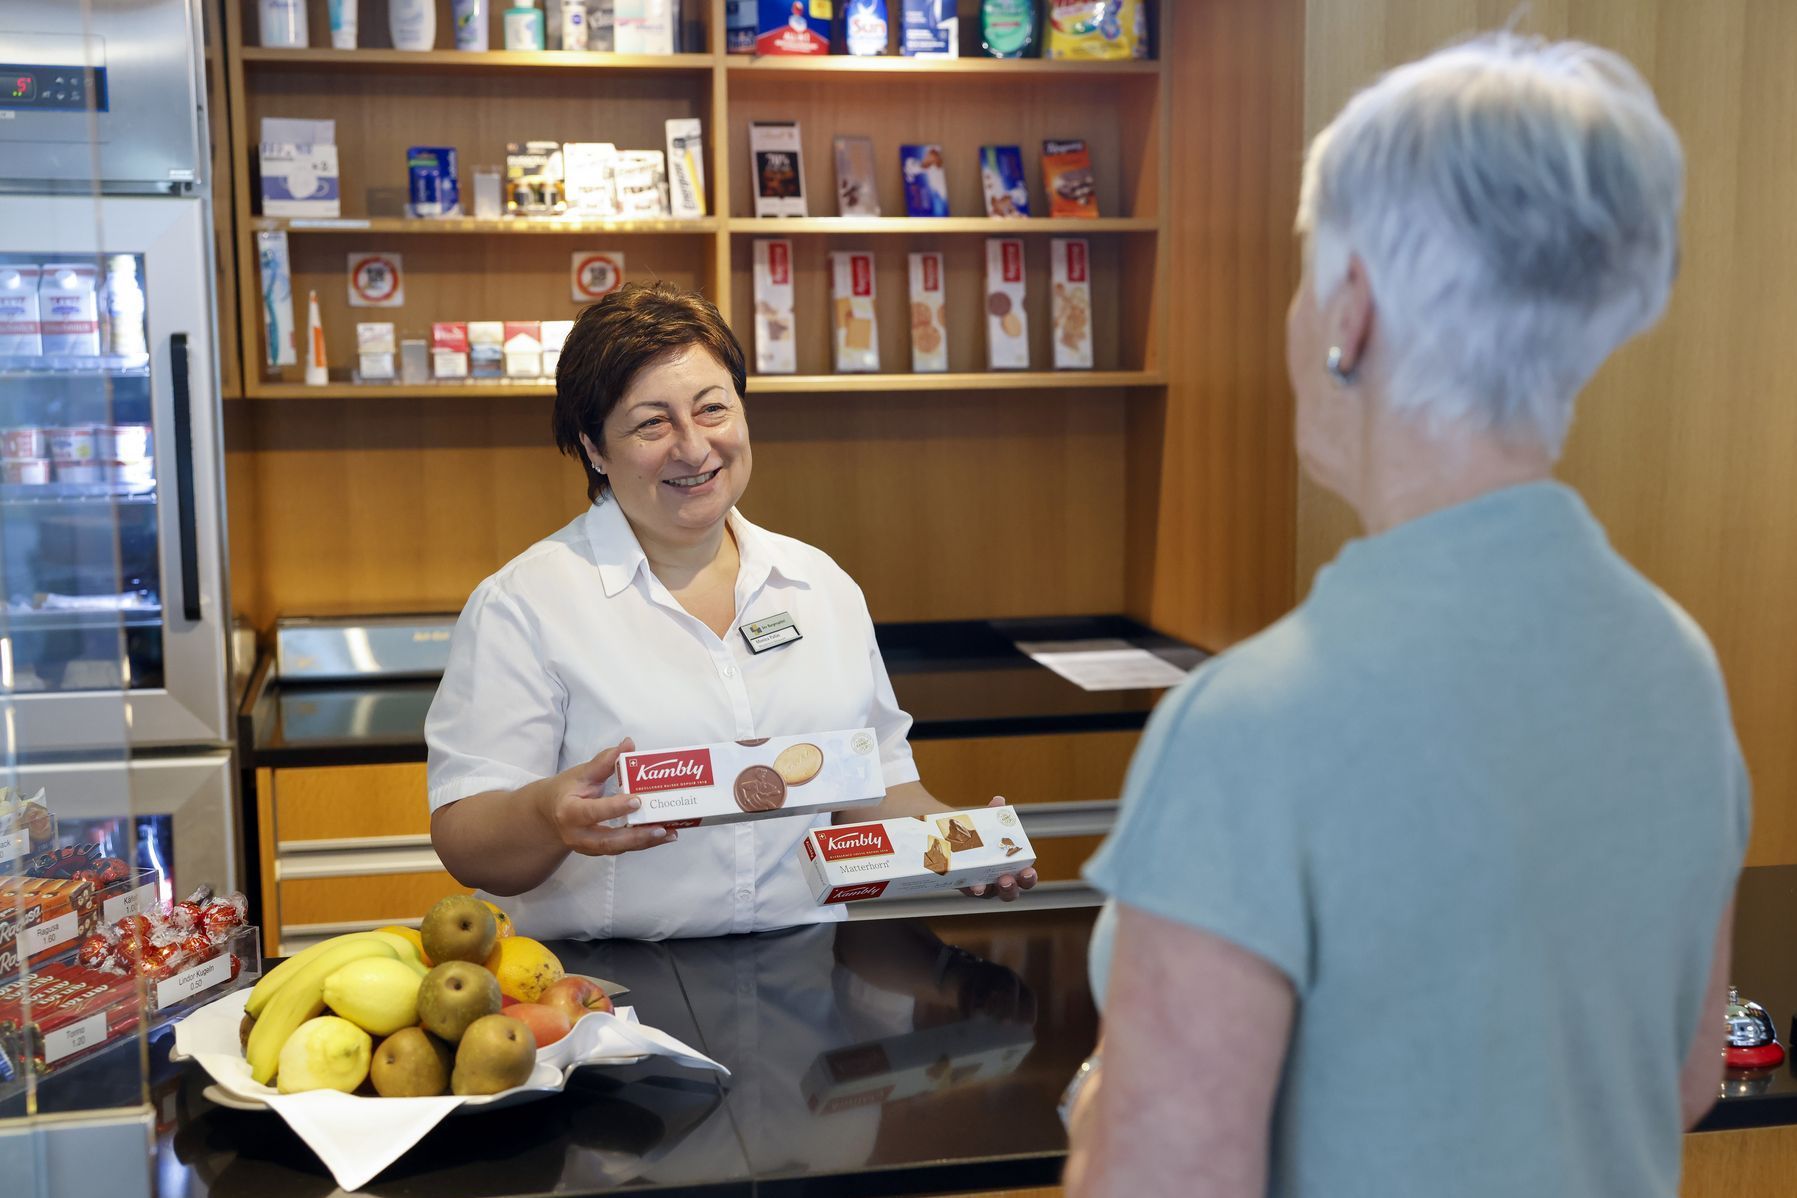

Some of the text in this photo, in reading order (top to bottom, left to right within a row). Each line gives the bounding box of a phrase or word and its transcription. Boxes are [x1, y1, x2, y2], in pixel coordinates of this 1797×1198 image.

[636, 759, 704, 781] Kambly
[649, 795, 698, 810] Chocolait
[828, 832, 882, 851] Kambly
[833, 886, 881, 899] Kambly
[37, 923, 59, 937] Ragusa
[178, 964, 215, 986] Lindor Kugeln
